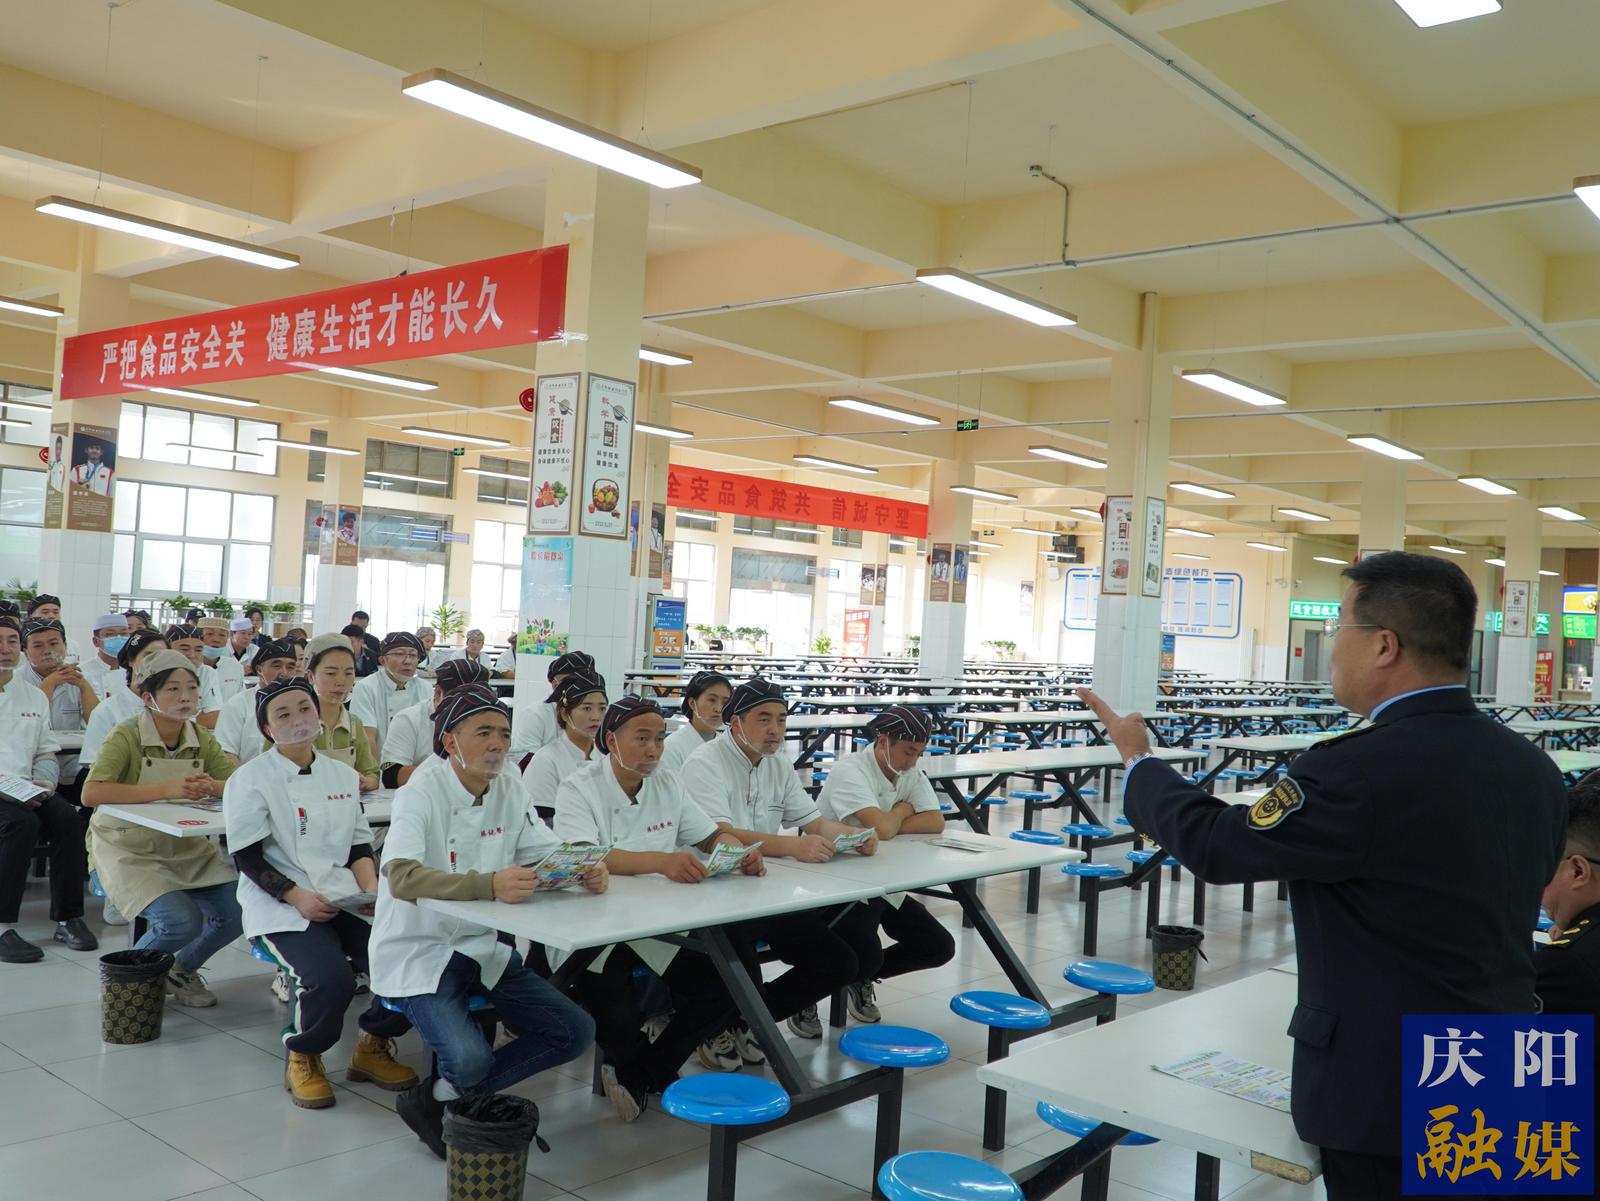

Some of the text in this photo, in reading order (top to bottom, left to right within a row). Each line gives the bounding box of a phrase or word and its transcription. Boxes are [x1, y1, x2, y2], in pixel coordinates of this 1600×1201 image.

[100, 275, 504, 384] 严把食品安全关 健康生活才能长久
